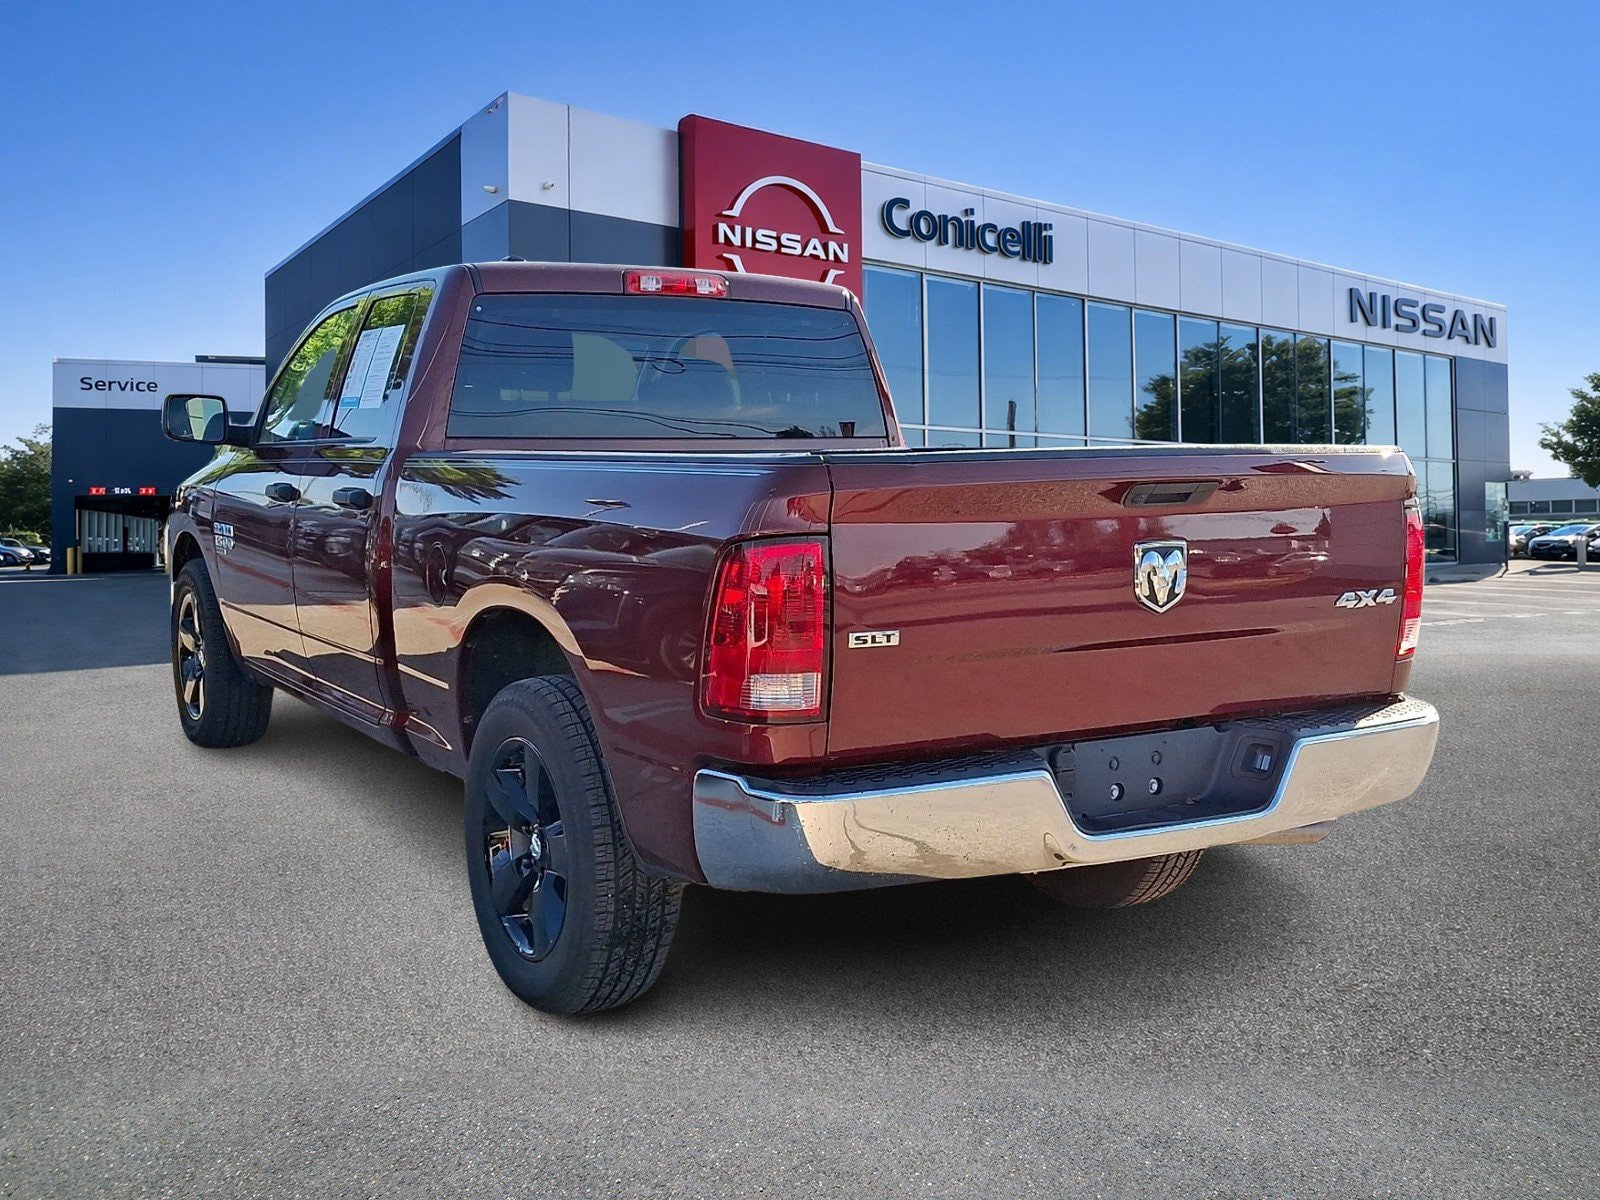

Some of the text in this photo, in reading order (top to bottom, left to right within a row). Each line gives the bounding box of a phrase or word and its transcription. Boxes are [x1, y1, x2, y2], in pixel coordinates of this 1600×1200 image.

[717, 222, 849, 263] NISSAN
[883, 197, 1054, 264] Conicelli
[1349, 287, 1497, 348] NISSAN
[80, 376, 158, 392] Service
[853, 632, 896, 646] SLT
